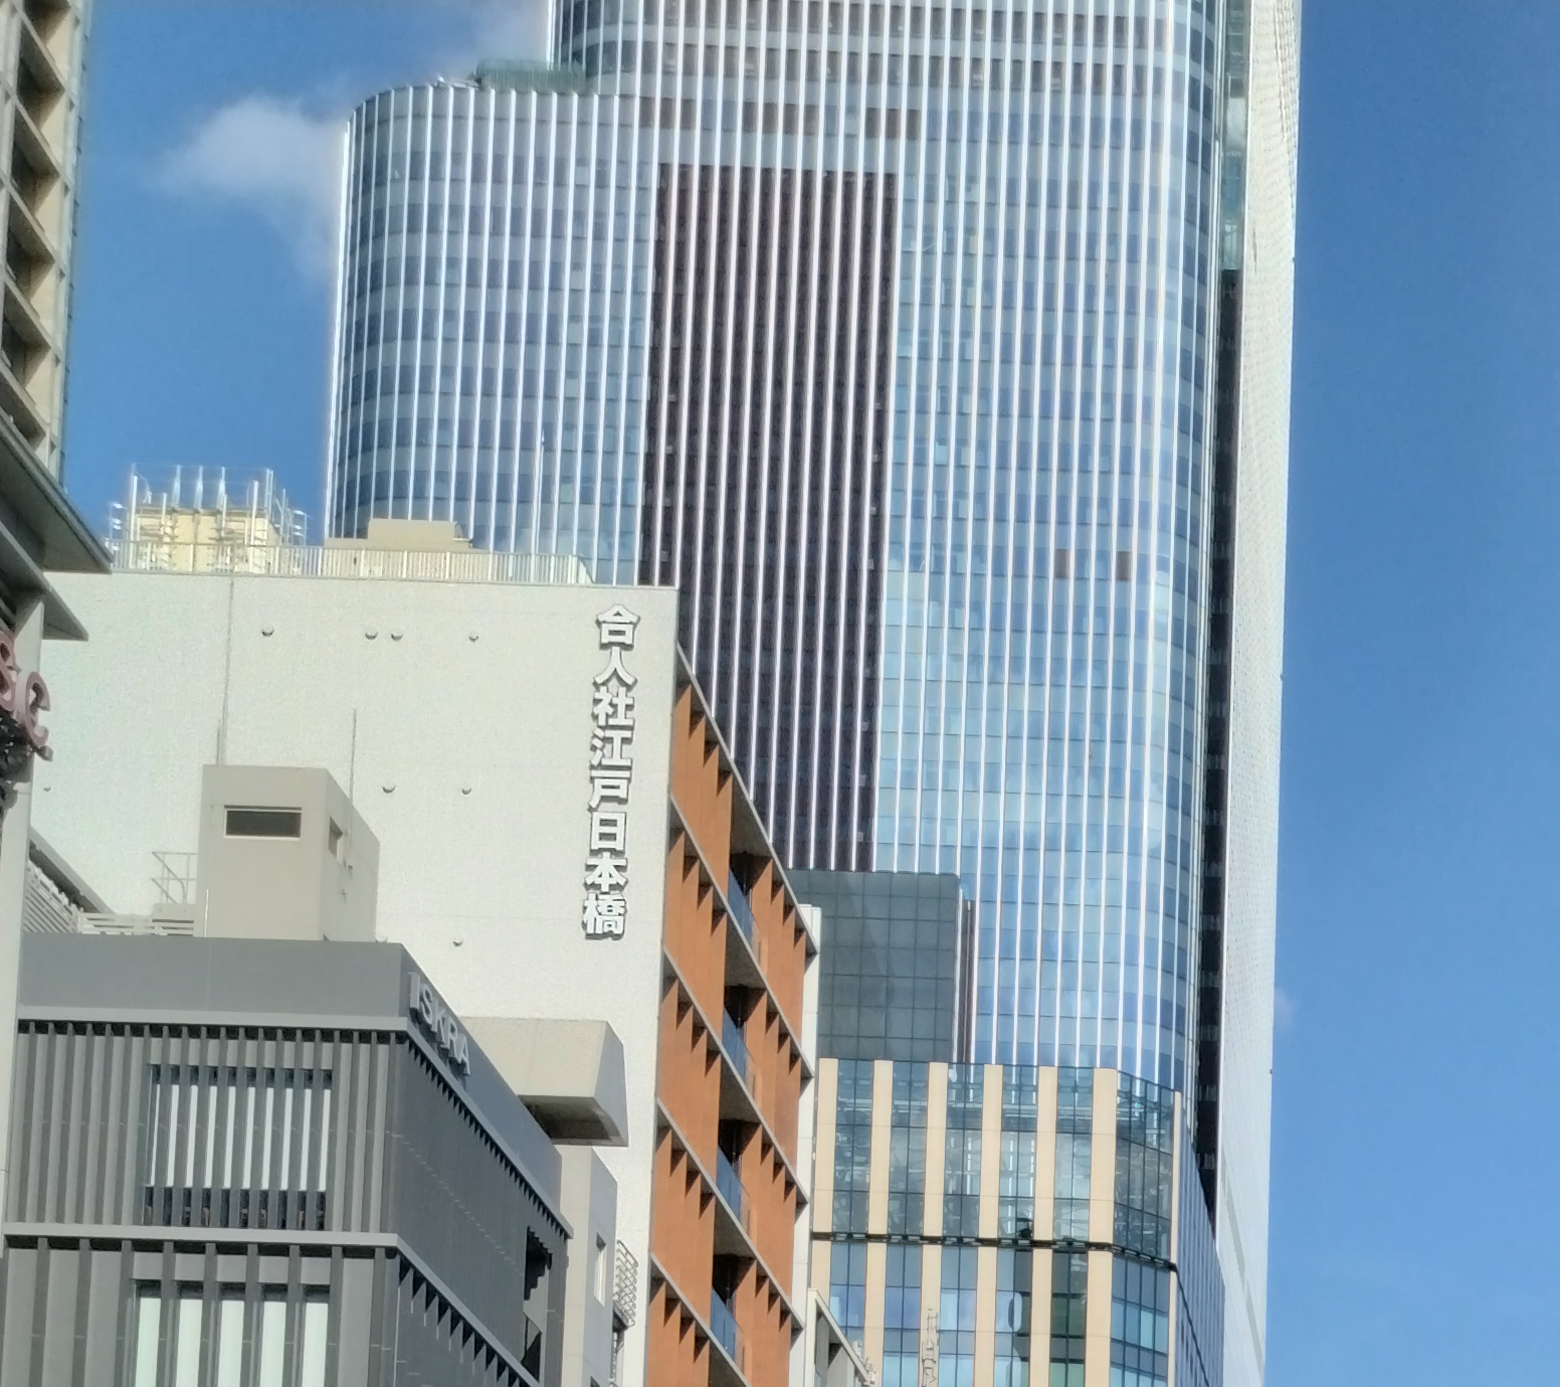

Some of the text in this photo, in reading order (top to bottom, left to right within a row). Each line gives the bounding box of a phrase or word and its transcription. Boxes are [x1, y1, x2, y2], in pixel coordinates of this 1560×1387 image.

[581, 604, 641, 941] 合人社江戸日本橋
[408, 971, 471, 1076] ISKRA
